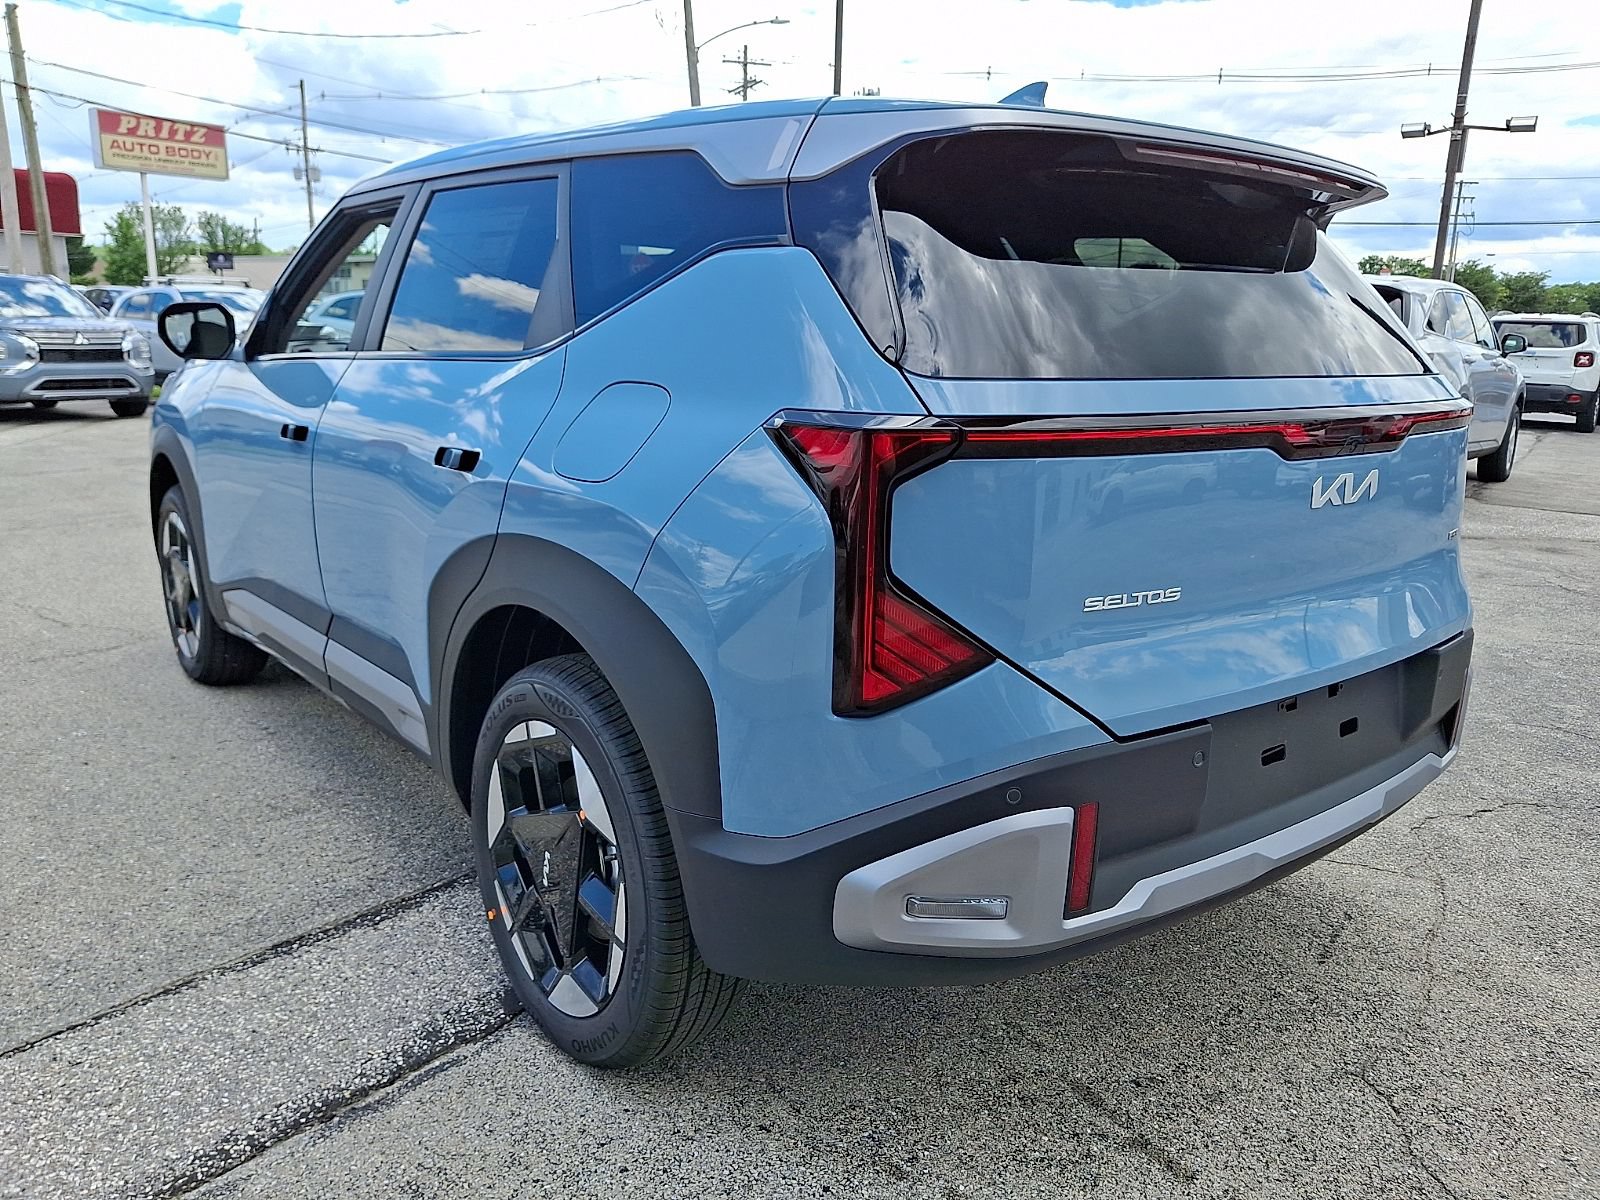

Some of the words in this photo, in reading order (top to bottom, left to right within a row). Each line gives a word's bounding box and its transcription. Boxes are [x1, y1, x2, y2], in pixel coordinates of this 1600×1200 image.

[117, 115, 208, 144] PRITZ
[110, 139, 160, 155] AUTO
[165, 145, 213, 161] BODY
[1310, 469, 1380, 509] KIA
[1083, 586, 1182, 613] SELTOS
[571, 1021, 620, 1054] KUMHO
